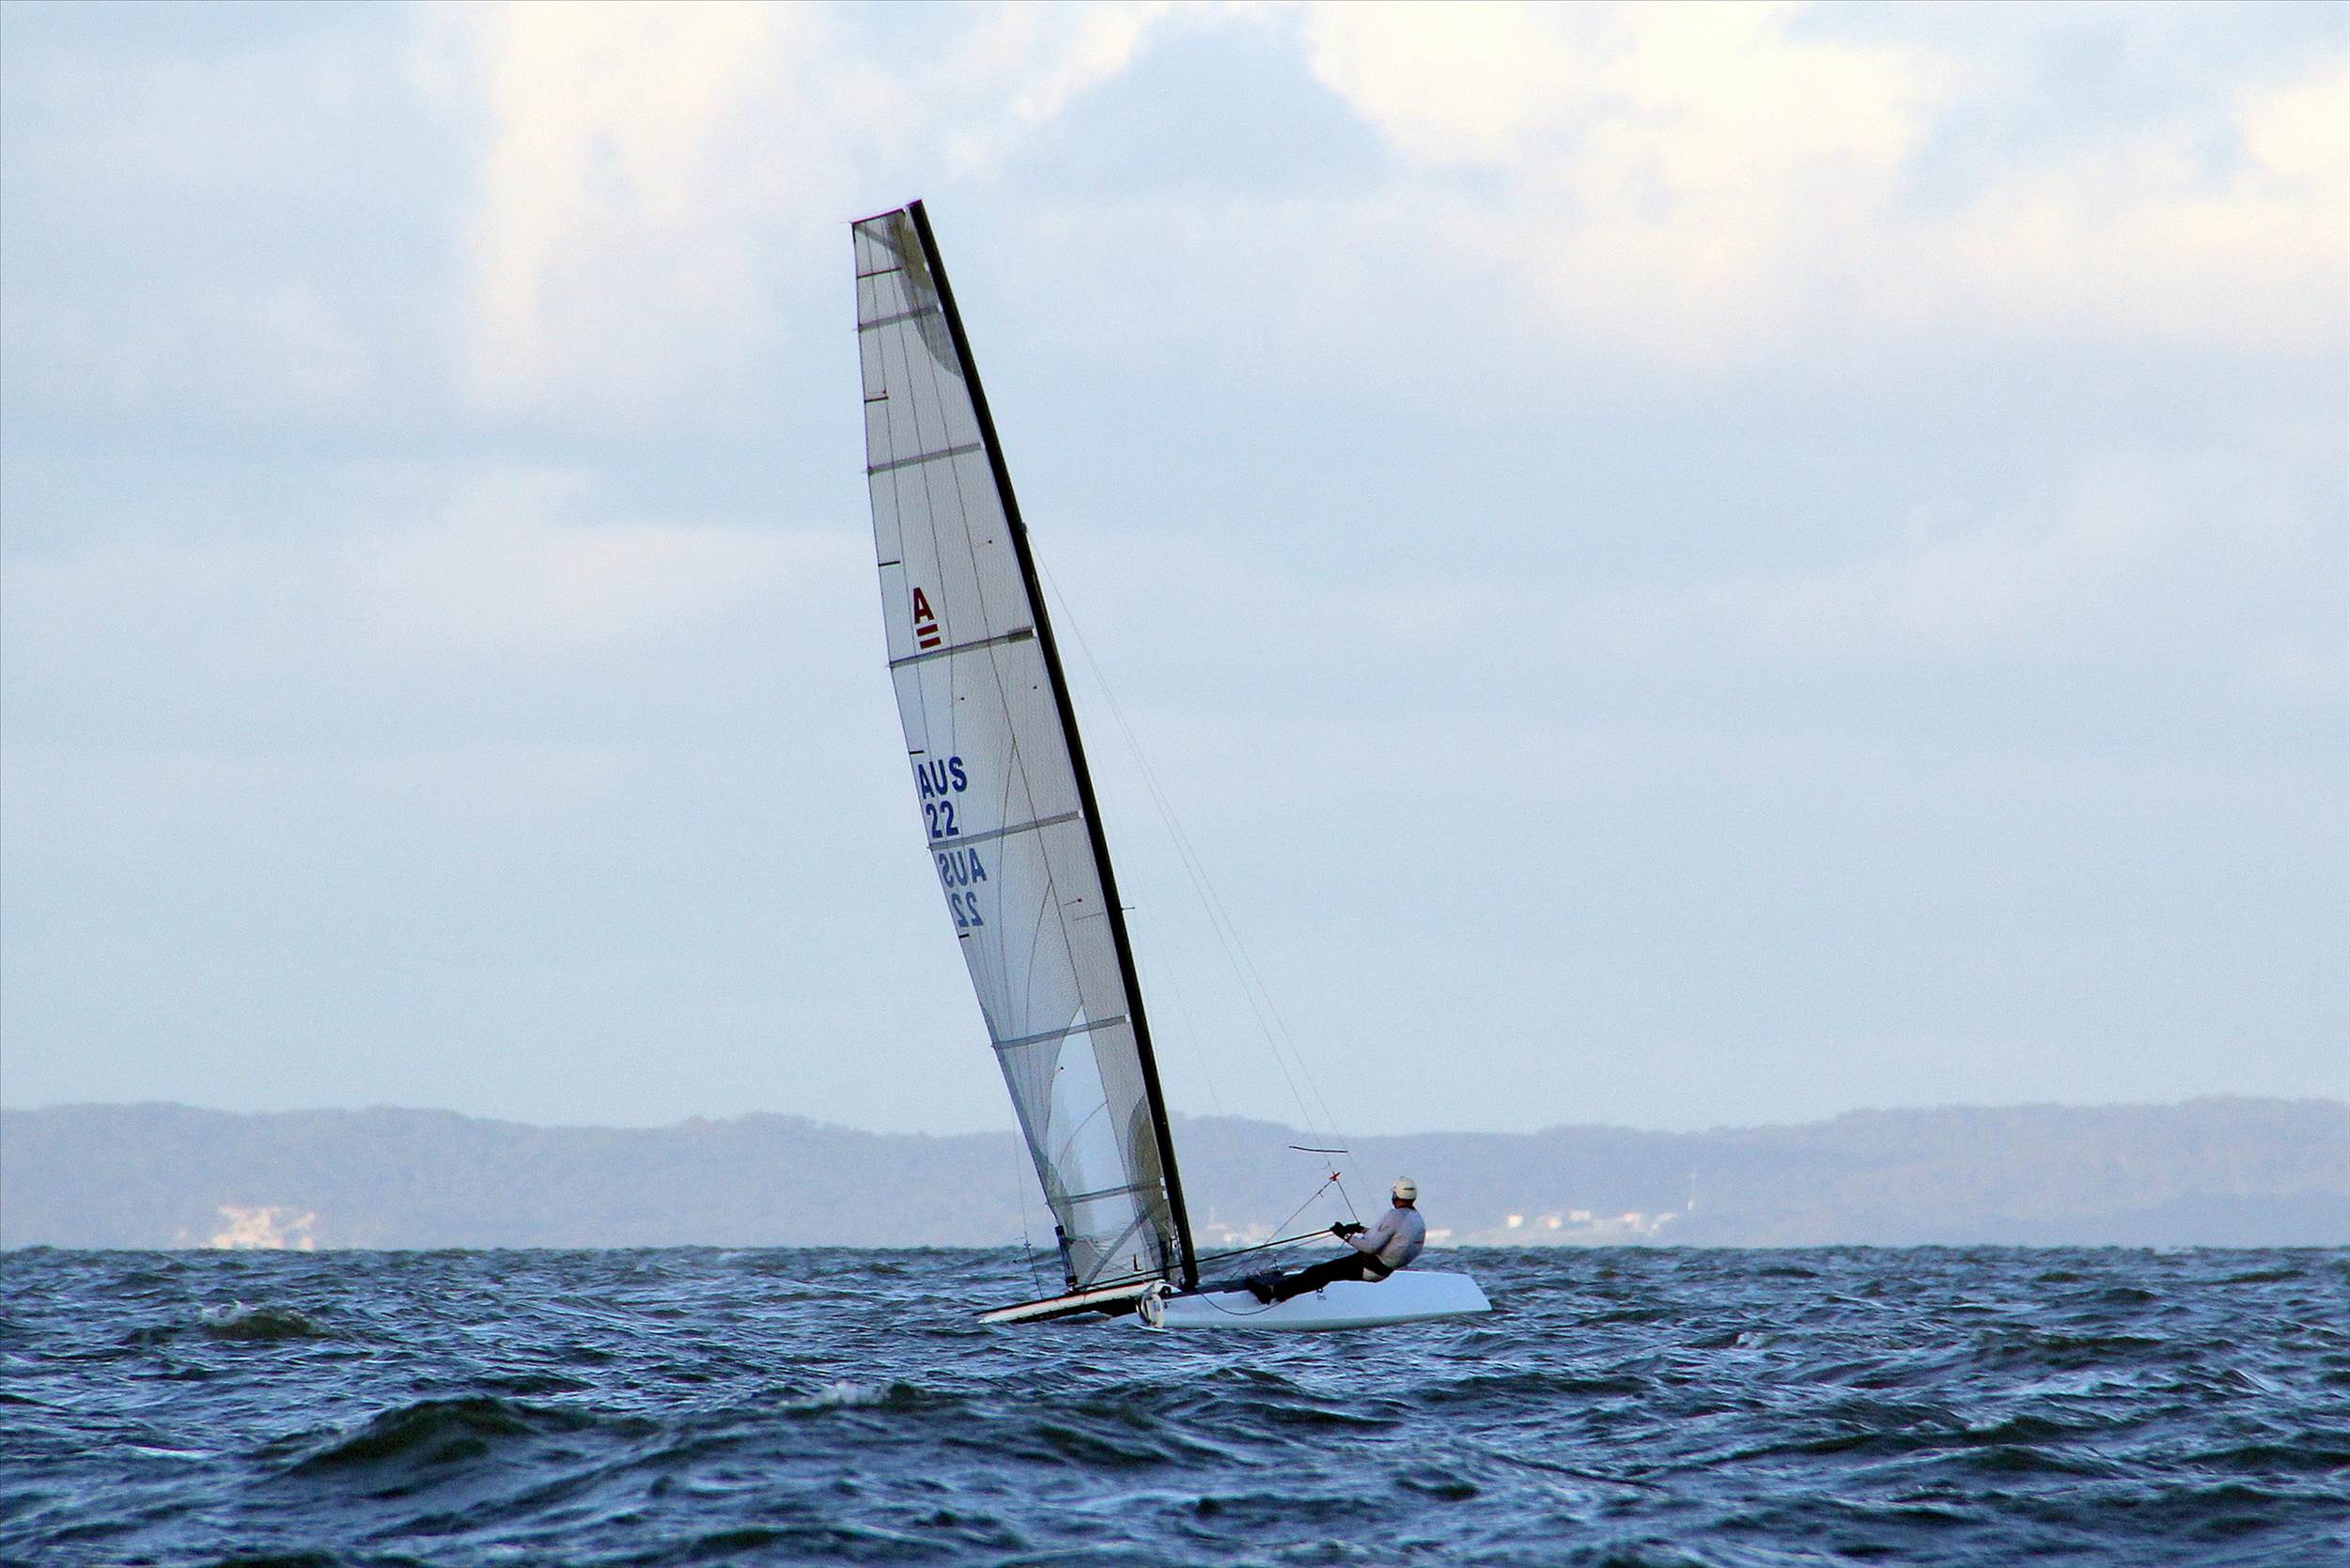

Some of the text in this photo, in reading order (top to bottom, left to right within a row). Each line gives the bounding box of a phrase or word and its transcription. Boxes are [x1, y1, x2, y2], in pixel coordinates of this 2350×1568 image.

[912, 586, 935, 625] A
[917, 755, 968, 800] AUS
[926, 800, 959, 839] 22
